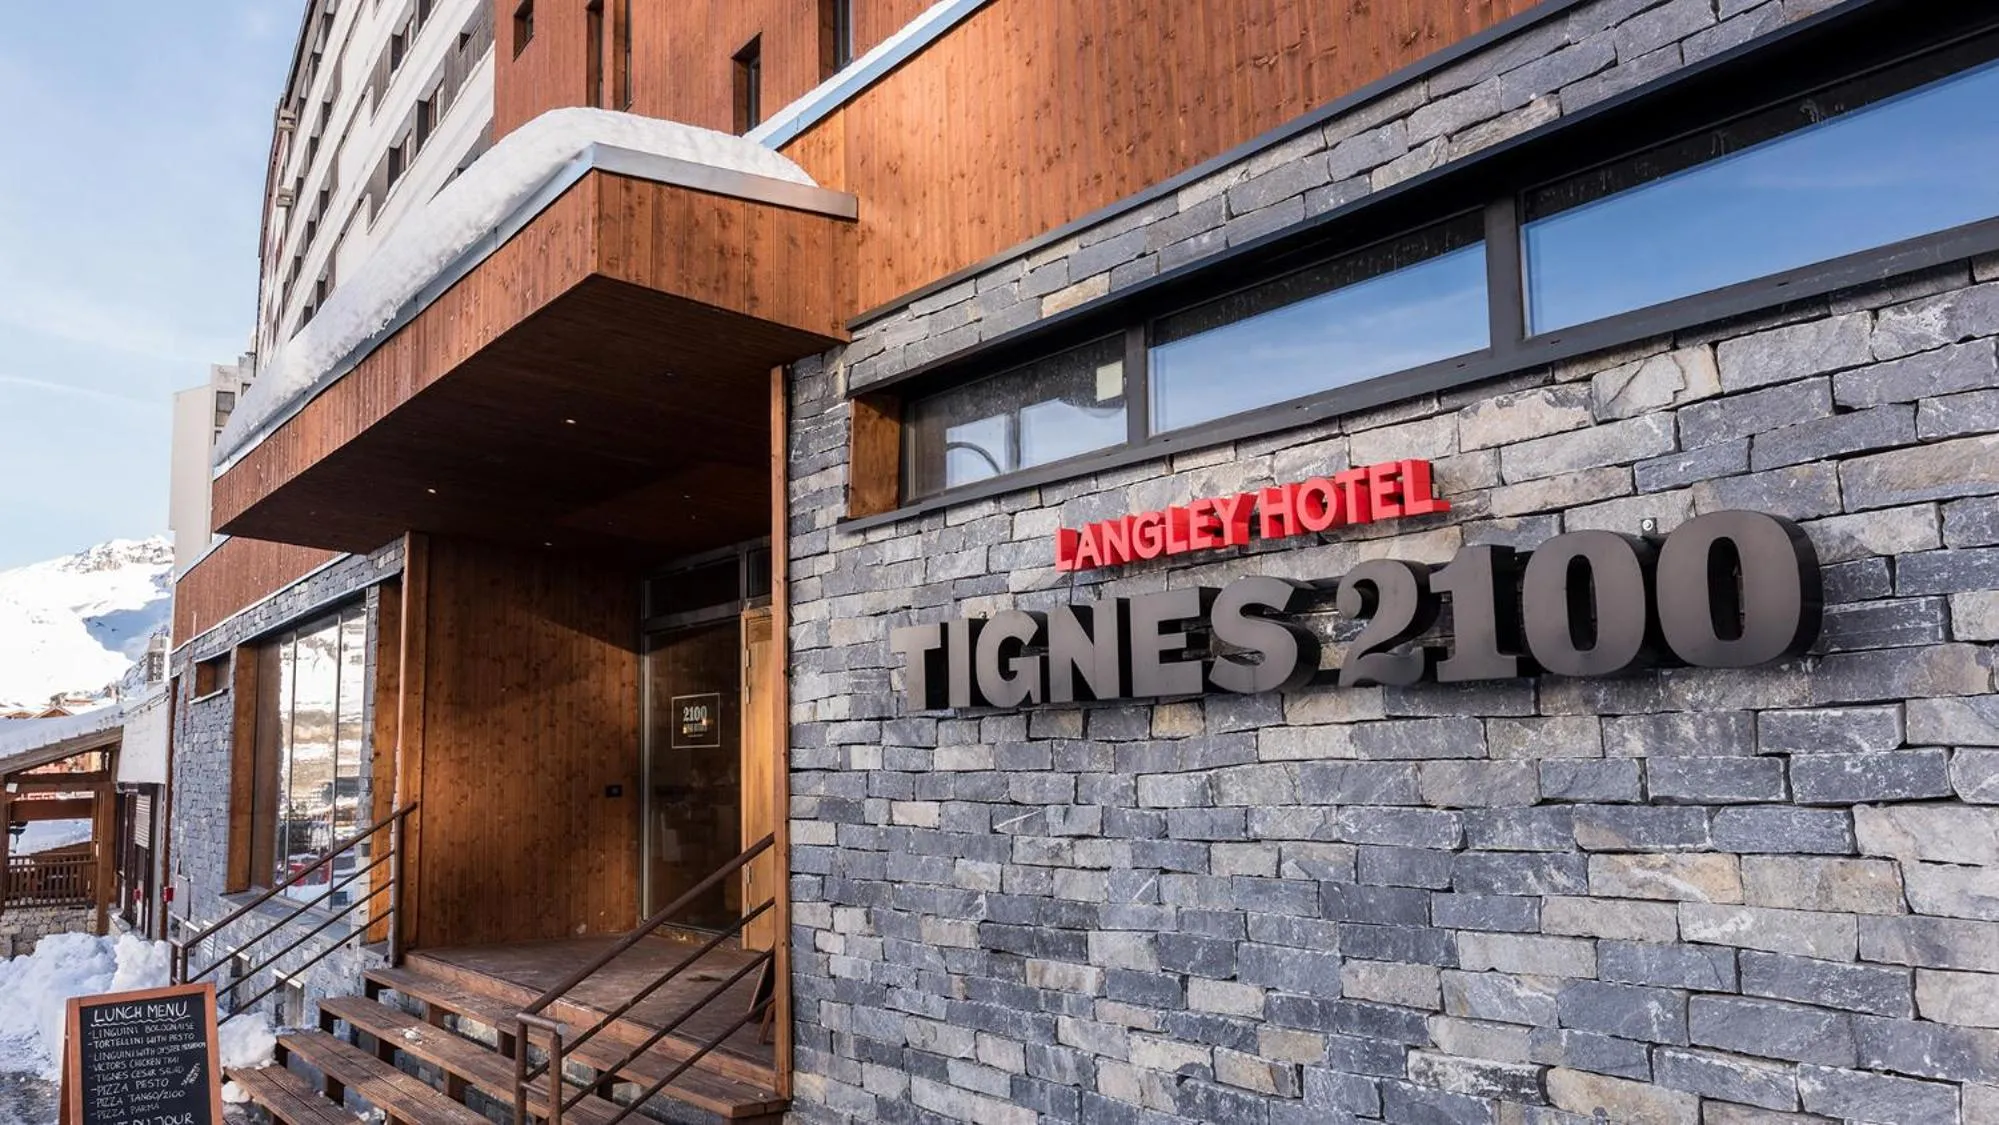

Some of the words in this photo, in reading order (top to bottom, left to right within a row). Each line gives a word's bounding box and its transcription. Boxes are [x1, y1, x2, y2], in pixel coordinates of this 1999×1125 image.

[1056, 492, 1258, 573] LANGLEY
[1259, 459, 1450, 540] HOTEL
[890, 575, 1318, 711] TIGNES
[1335, 510, 1822, 688] 2100
[683, 706, 707, 722] 2100
[94, 1005, 142, 1022] LUNCH
[147, 1000, 187, 1018] MENU
[92, 1026, 139, 1039] LINGUINI
[94, 1037, 144, 1049] TORTELLINI
[146, 1035, 167, 1044] WITH
[169, 1032, 195, 1042] PESTO
[136, 1047, 155, 1057] WITH
[96, 1083, 129, 1096] PIZZA
[135, 1078, 169, 1090] PESTO
[96, 1096, 123, 1108] PIZZA
[96, 1107, 125, 1119] PIZZA
[154, 1112, 194, 1125] JOUR
